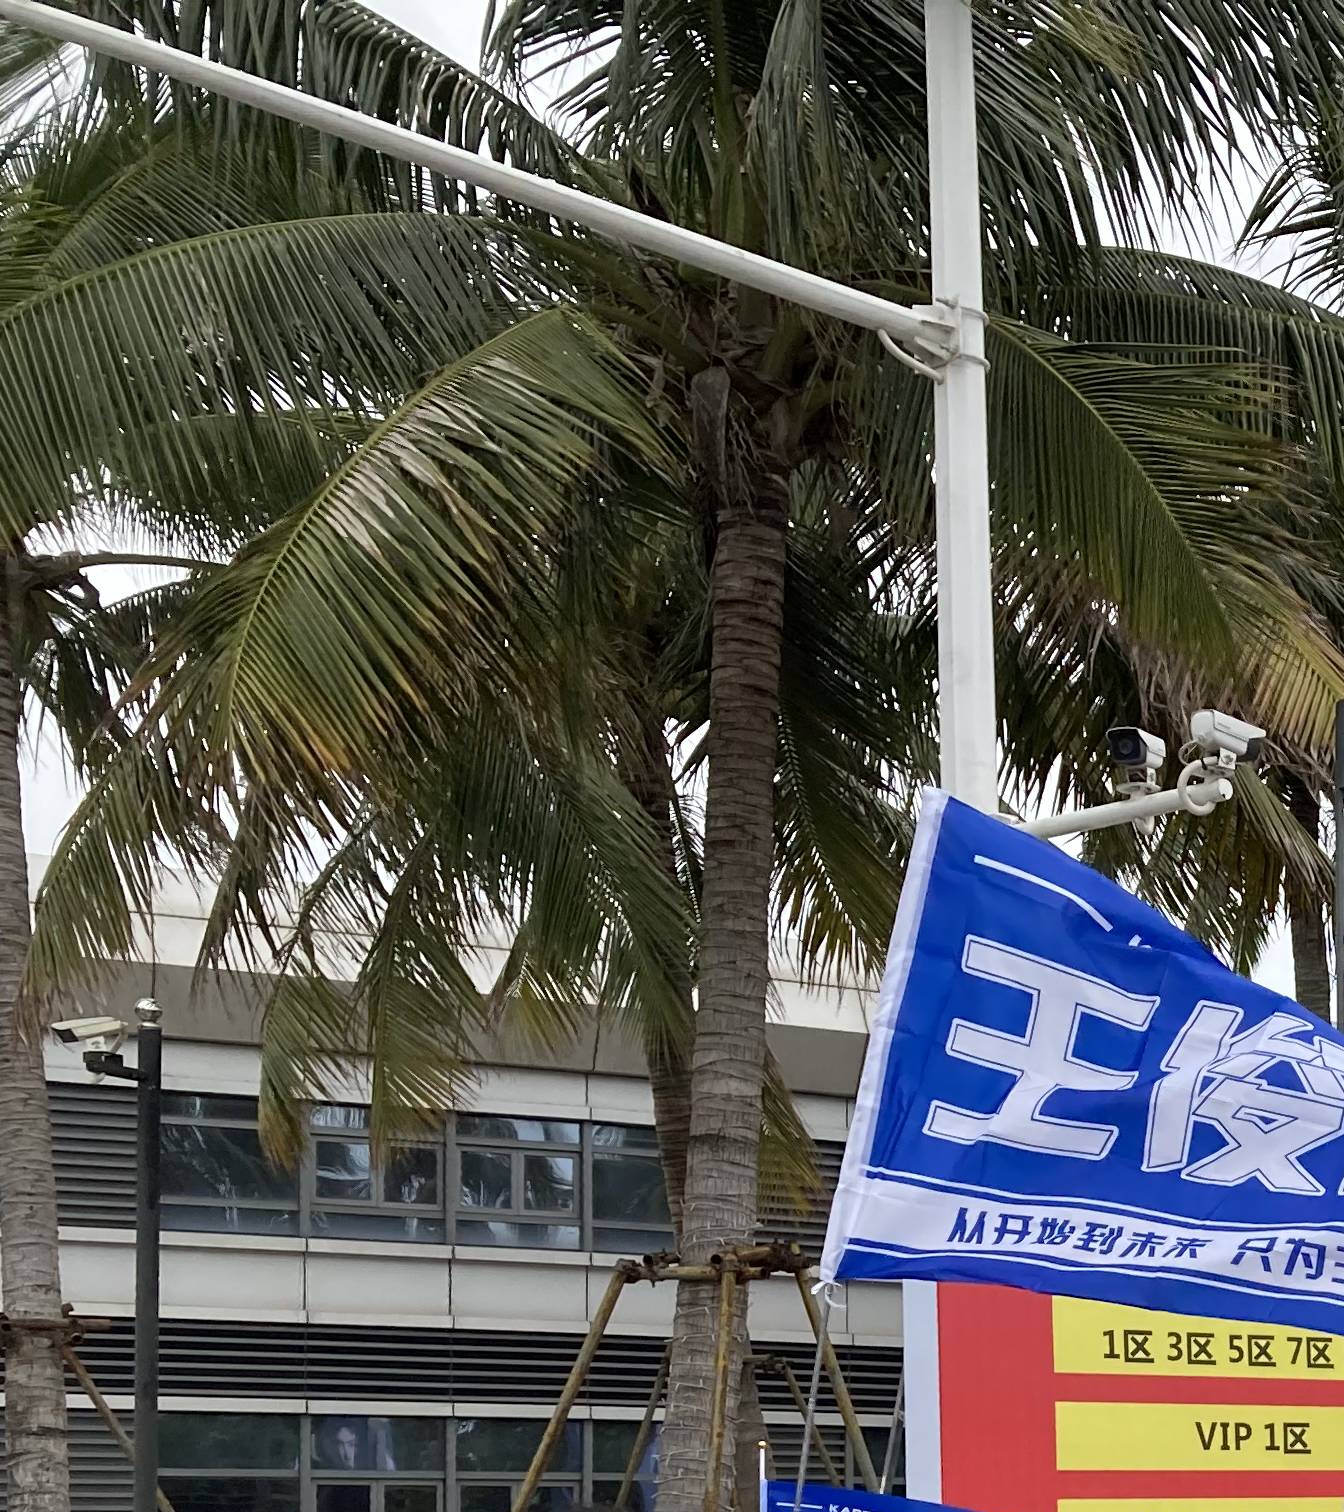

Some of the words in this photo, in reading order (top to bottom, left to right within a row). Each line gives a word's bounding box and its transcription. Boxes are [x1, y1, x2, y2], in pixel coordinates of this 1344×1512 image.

[947, 1208, 1214, 1261] 从开始到未来
[1102, 1329, 1154, 1363] 1区
[1166, 1332, 1217, 1365] 3区
[1228, 1334, 1277, 1367] 5区
[1286, 1337, 1335, 1369] 7区
[1195, 1421, 1253, 1451] VIP
[1264, 1422, 1311, 1454] 1区
